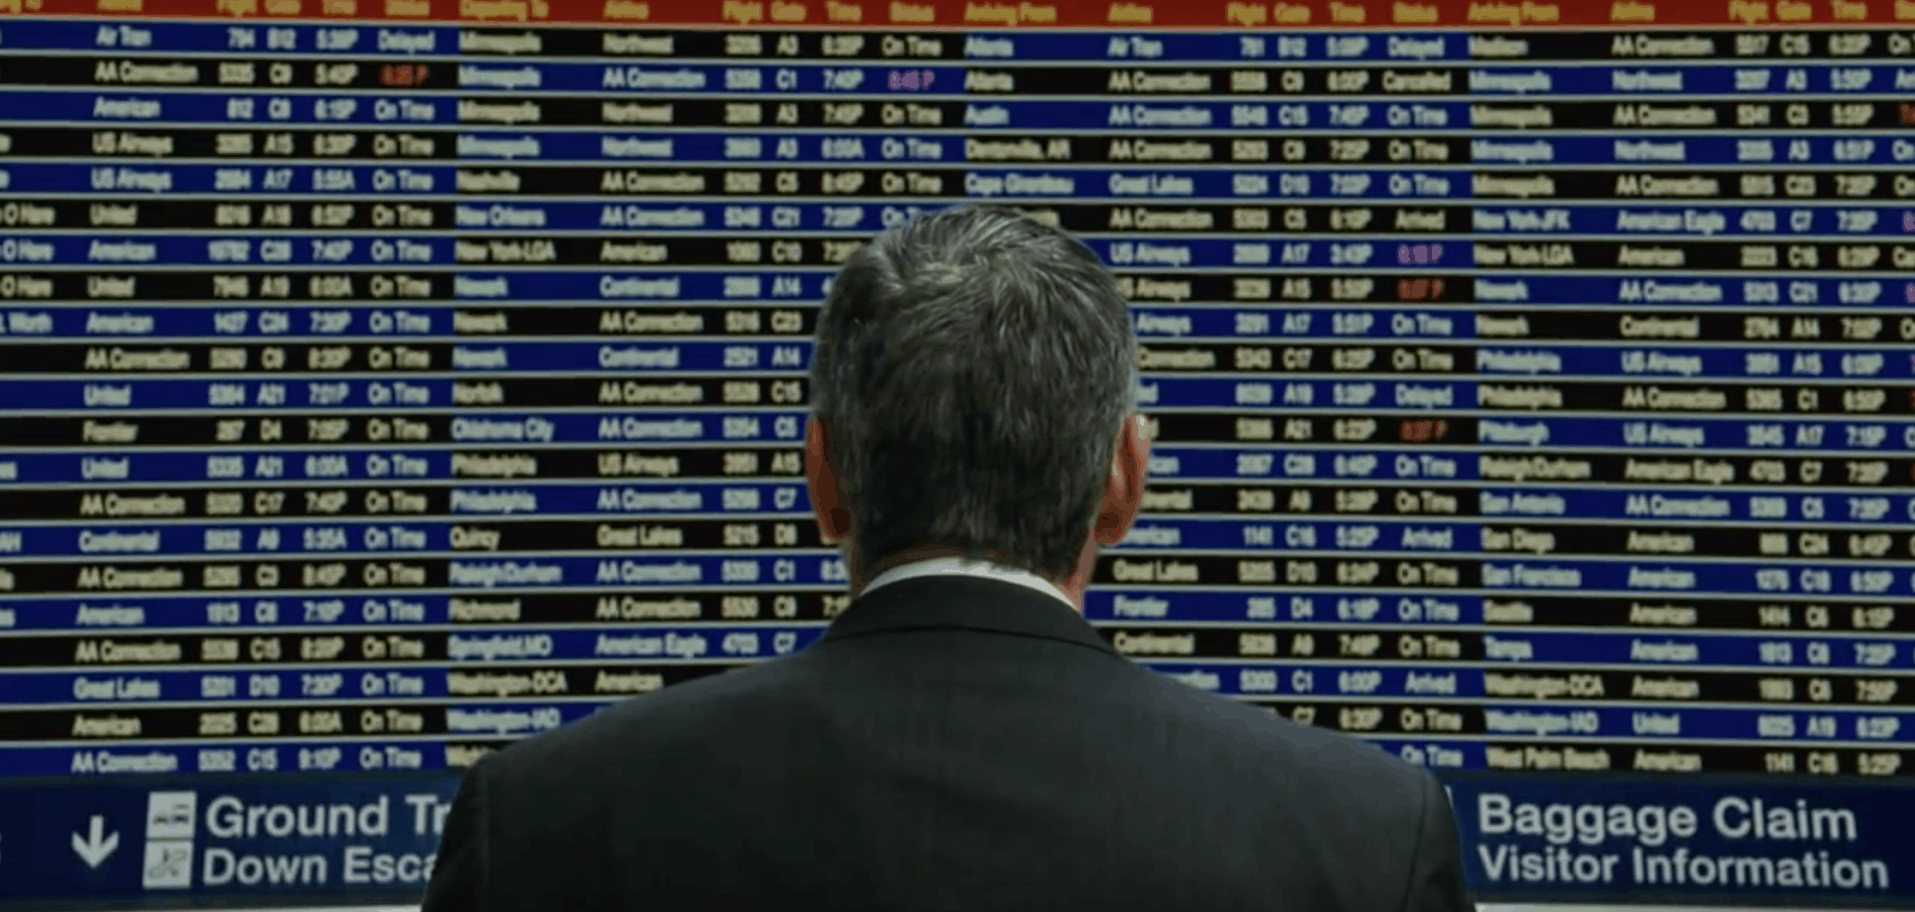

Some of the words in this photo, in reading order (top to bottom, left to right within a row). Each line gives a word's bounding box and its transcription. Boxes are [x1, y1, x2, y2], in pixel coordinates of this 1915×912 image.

[206, 796, 388, 837] Ground
[1478, 793, 1697, 845] Baggage
[1714, 796, 1857, 840] Claim
[203, 848, 327, 885] Down
[1477, 844, 1619, 882] Visitor
[1633, 846, 1889, 889] Information
